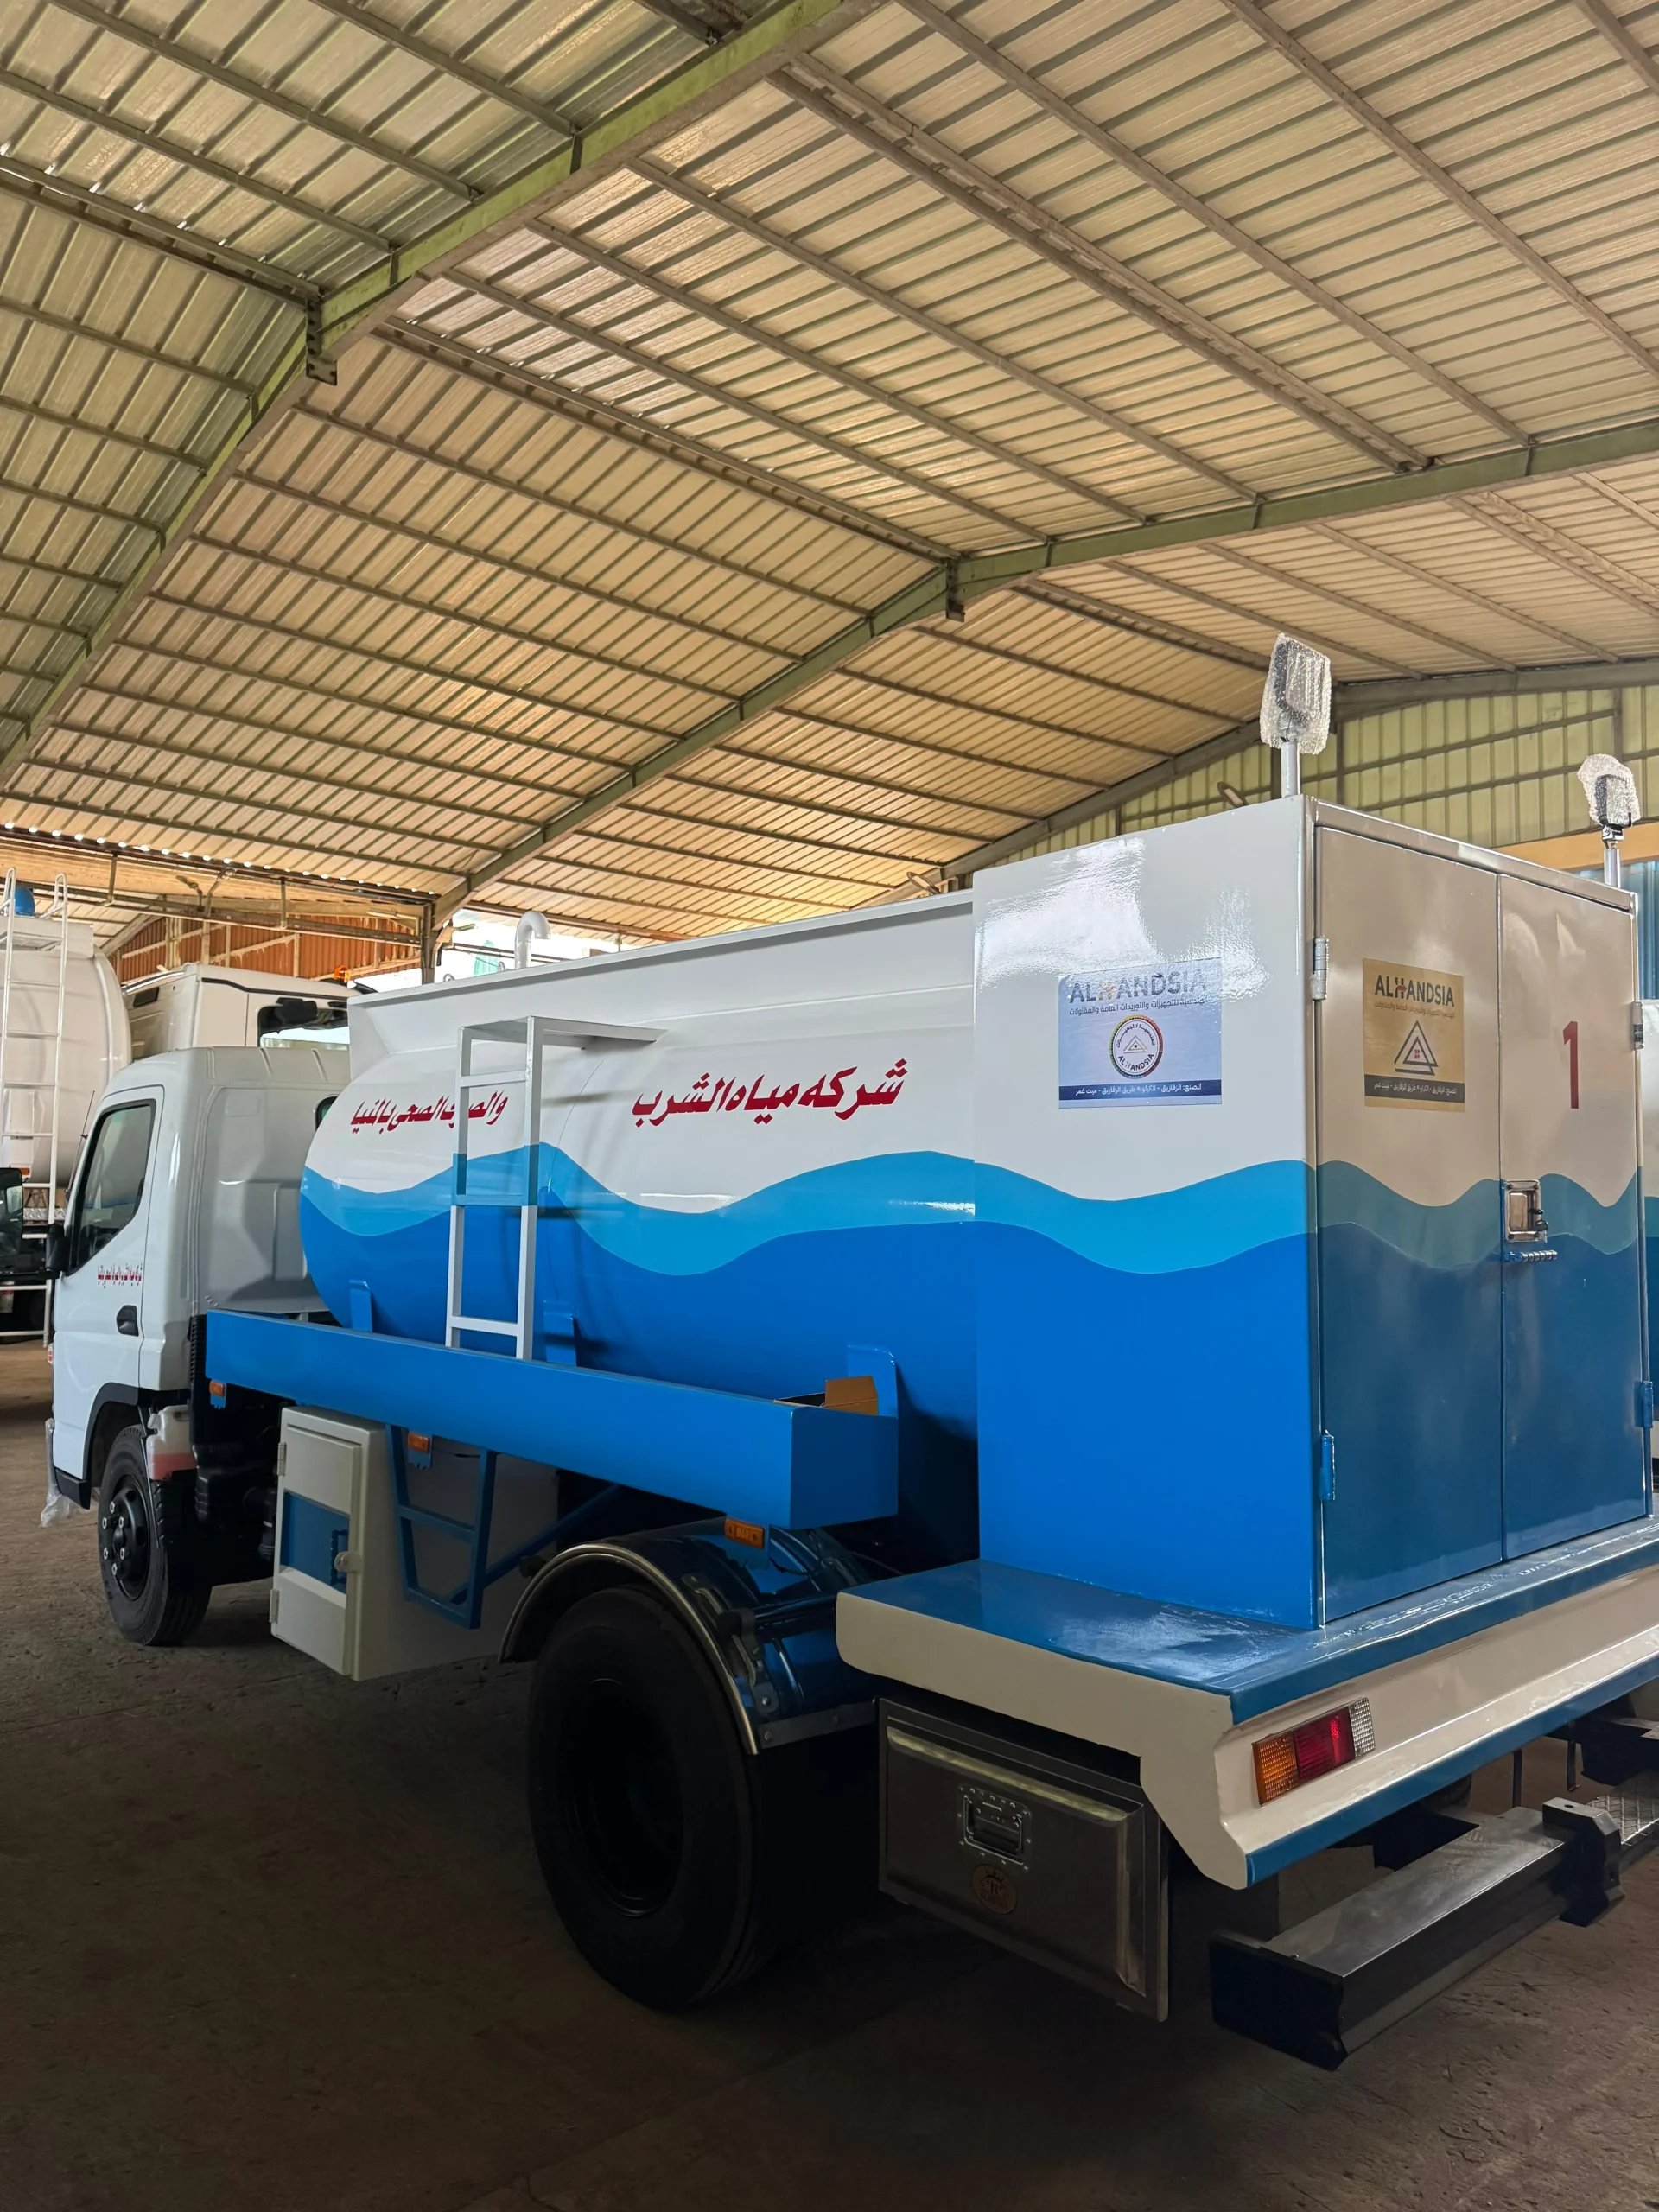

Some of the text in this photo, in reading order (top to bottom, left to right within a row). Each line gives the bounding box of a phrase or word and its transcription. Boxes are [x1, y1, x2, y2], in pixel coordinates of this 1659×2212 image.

[1069, 969, 1207, 1003] ALHANDSIA
[1374, 975, 1455, 1007] ALHANDSIA
[1069, 1006, 1100, 1015] والمقاولات
[1100, 1004, 1119, 1013] العامة
[1119, 1001, 1150, 1012] والتوريدات
[1151, 998, 1179, 1009] للتجهيزات
[1117, 1053, 1154, 1071] ALHANDSIA
[1563, 1020, 1580, 1109] 1
[632, 1072, 736, 1128] الشرب
[724, 1073, 801, 1125] مياه
[1141, 1084, 1156, 1094] الكيلو
[350, 1097, 398, 1135] بالمنيا
